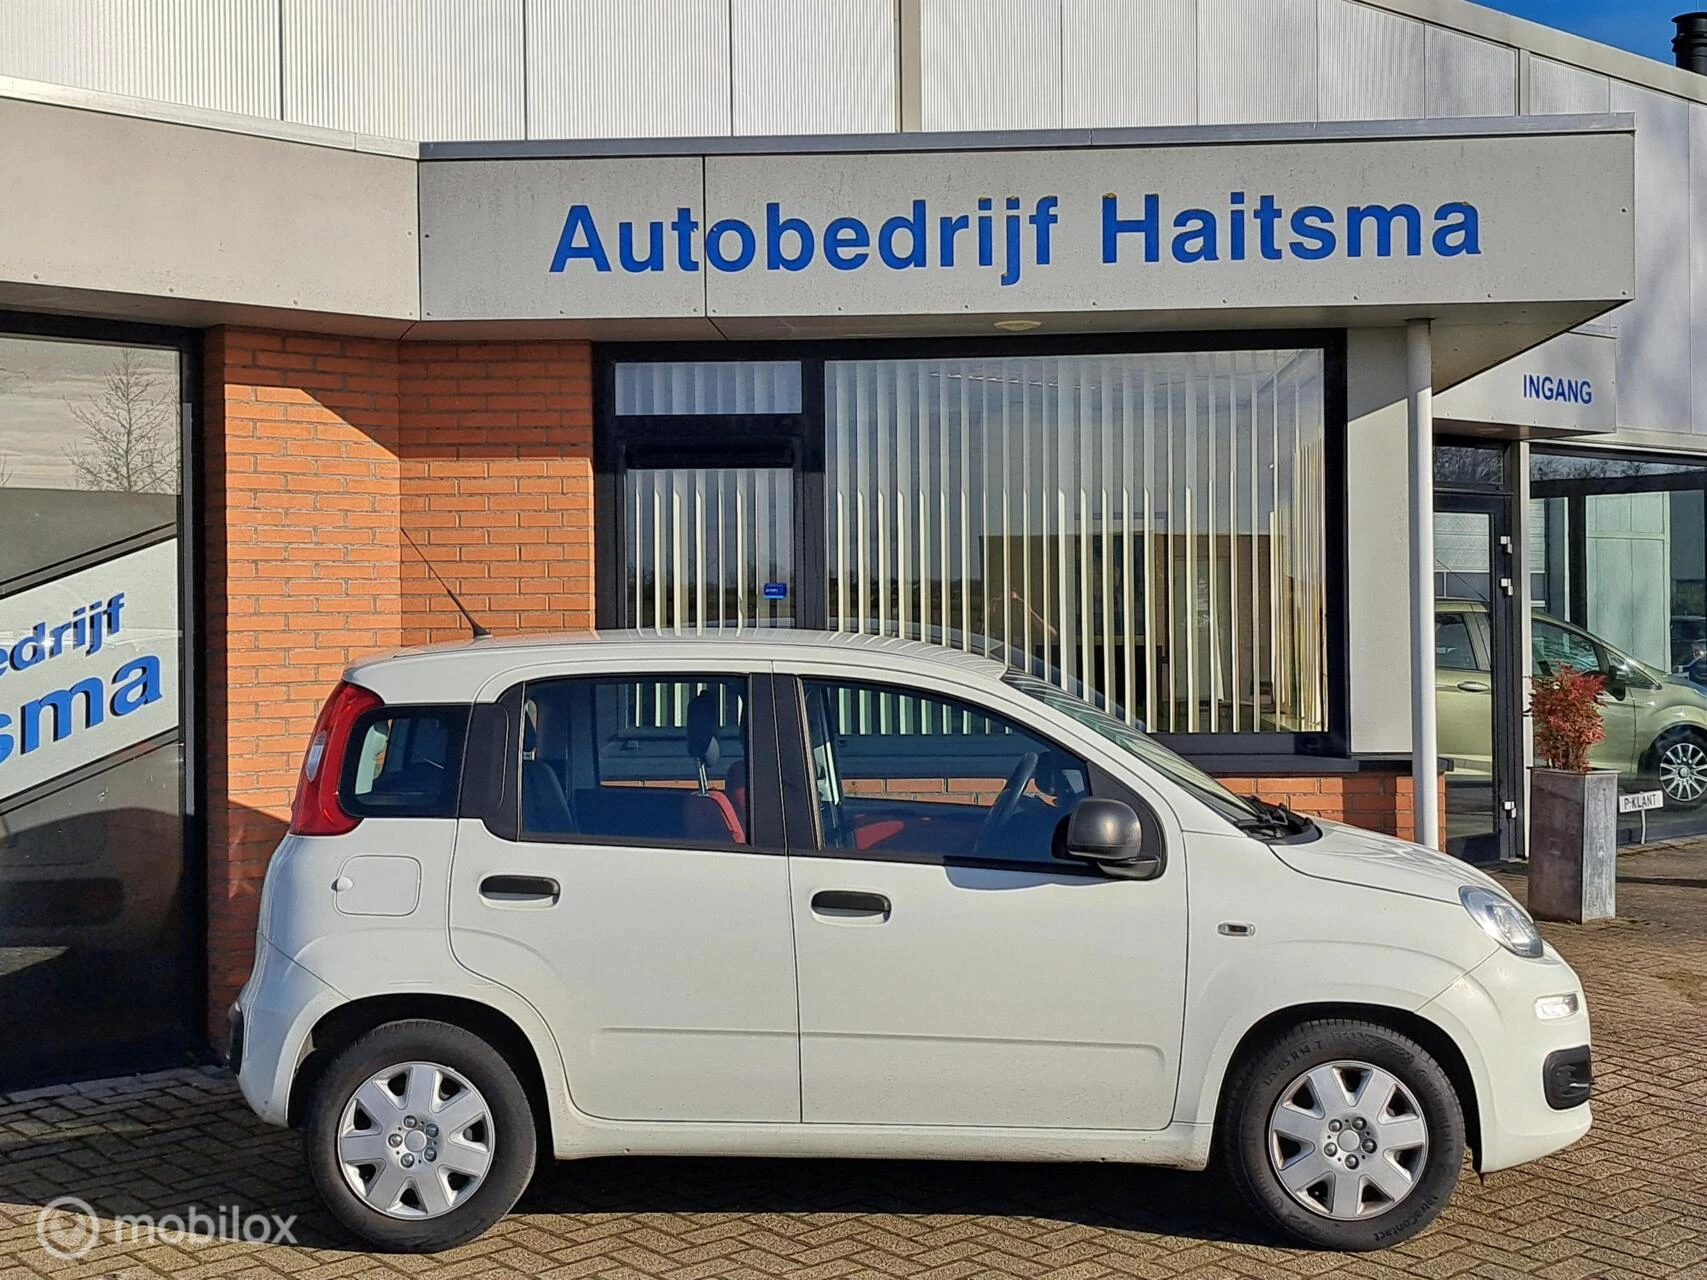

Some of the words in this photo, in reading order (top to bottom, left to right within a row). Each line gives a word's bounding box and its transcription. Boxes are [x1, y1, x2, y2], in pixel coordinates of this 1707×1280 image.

[549, 196, 1058, 285] Autobedrijf
[1102, 192, 1482, 264] Haitsma
[1523, 374, 1592, 404] INGANG
[0, 592, 125, 679] drijf
[0, 654, 163, 765] ma
